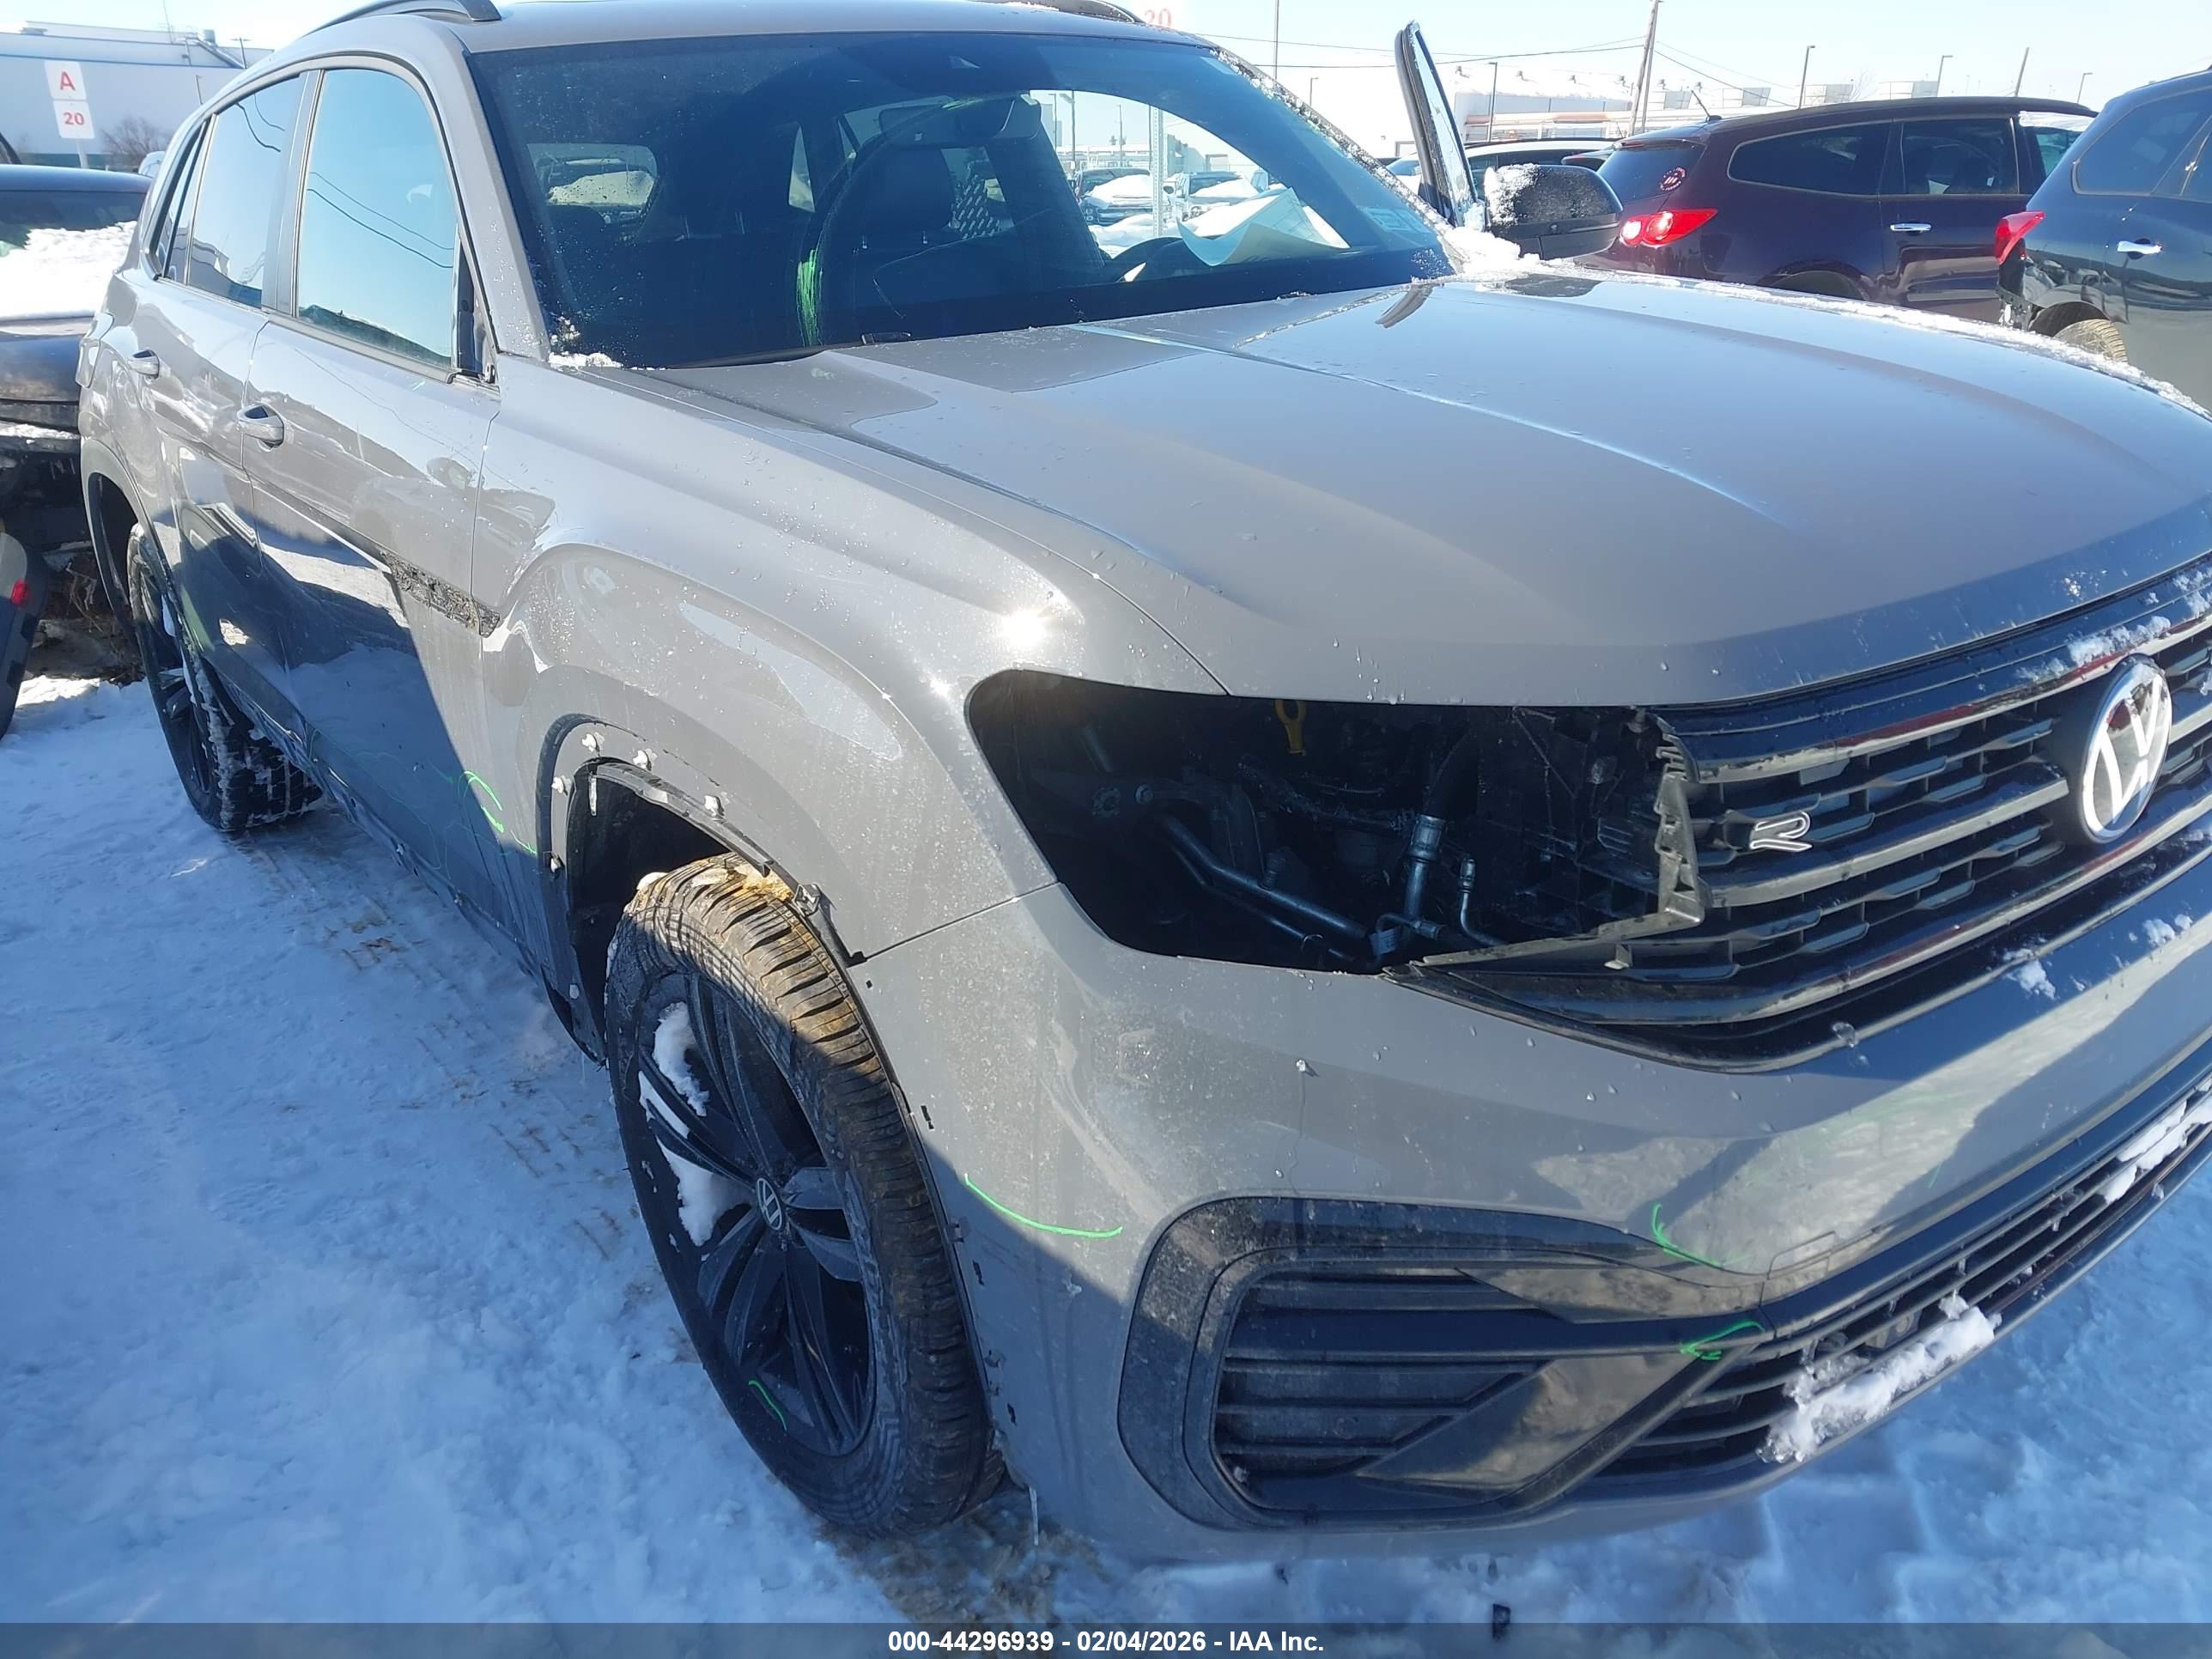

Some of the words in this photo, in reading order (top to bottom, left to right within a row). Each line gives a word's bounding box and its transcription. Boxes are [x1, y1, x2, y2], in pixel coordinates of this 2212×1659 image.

[59, 70, 76, 91] A
[63, 112, 84, 126] 20
[1748, 810, 1814, 853] R
